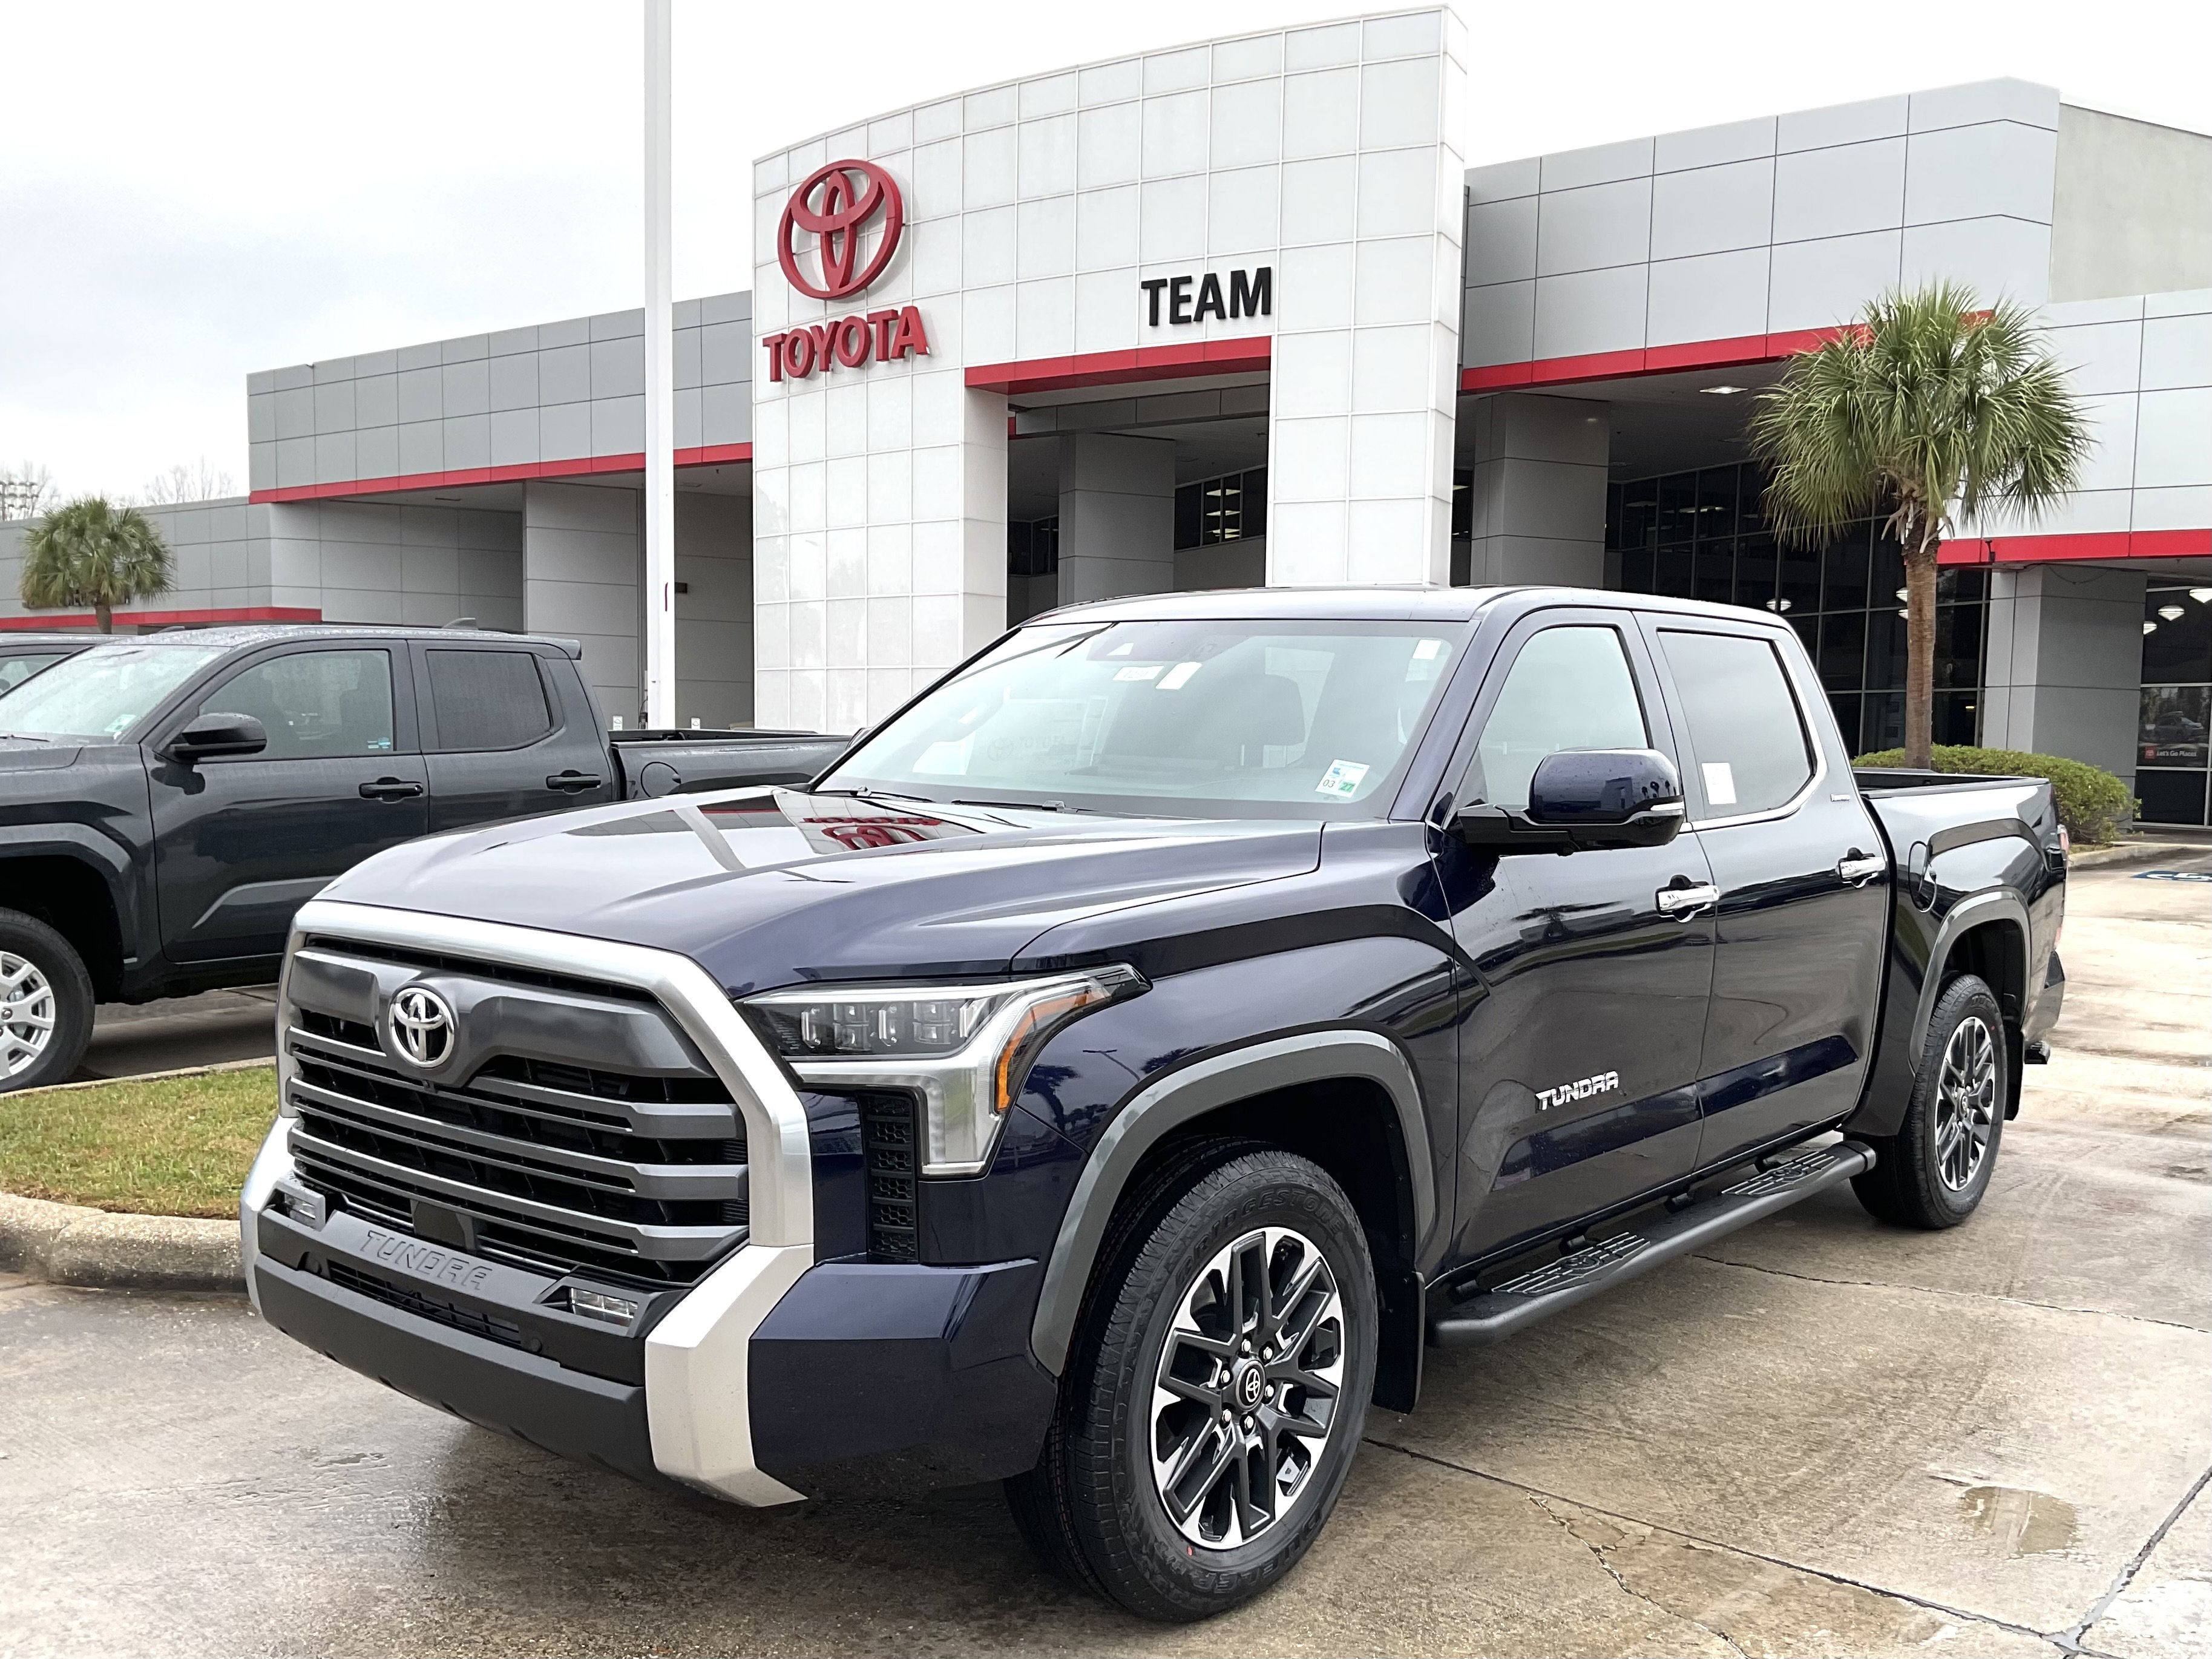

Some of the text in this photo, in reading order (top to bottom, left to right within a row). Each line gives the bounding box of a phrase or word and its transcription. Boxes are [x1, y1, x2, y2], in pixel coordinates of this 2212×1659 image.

[1141, 267, 1271, 326] TEAM
[763, 306, 930, 382] TOYOTA
[1323, 779, 1355, 791] 03 27
[1535, 1071, 1619, 1111] TUNDRA
[360, 1230, 493, 1290] TUNDRA
[1177, 1188, 1344, 1288] BRIDGESTONE
[1190, 1501, 1323, 1594] DUELER
